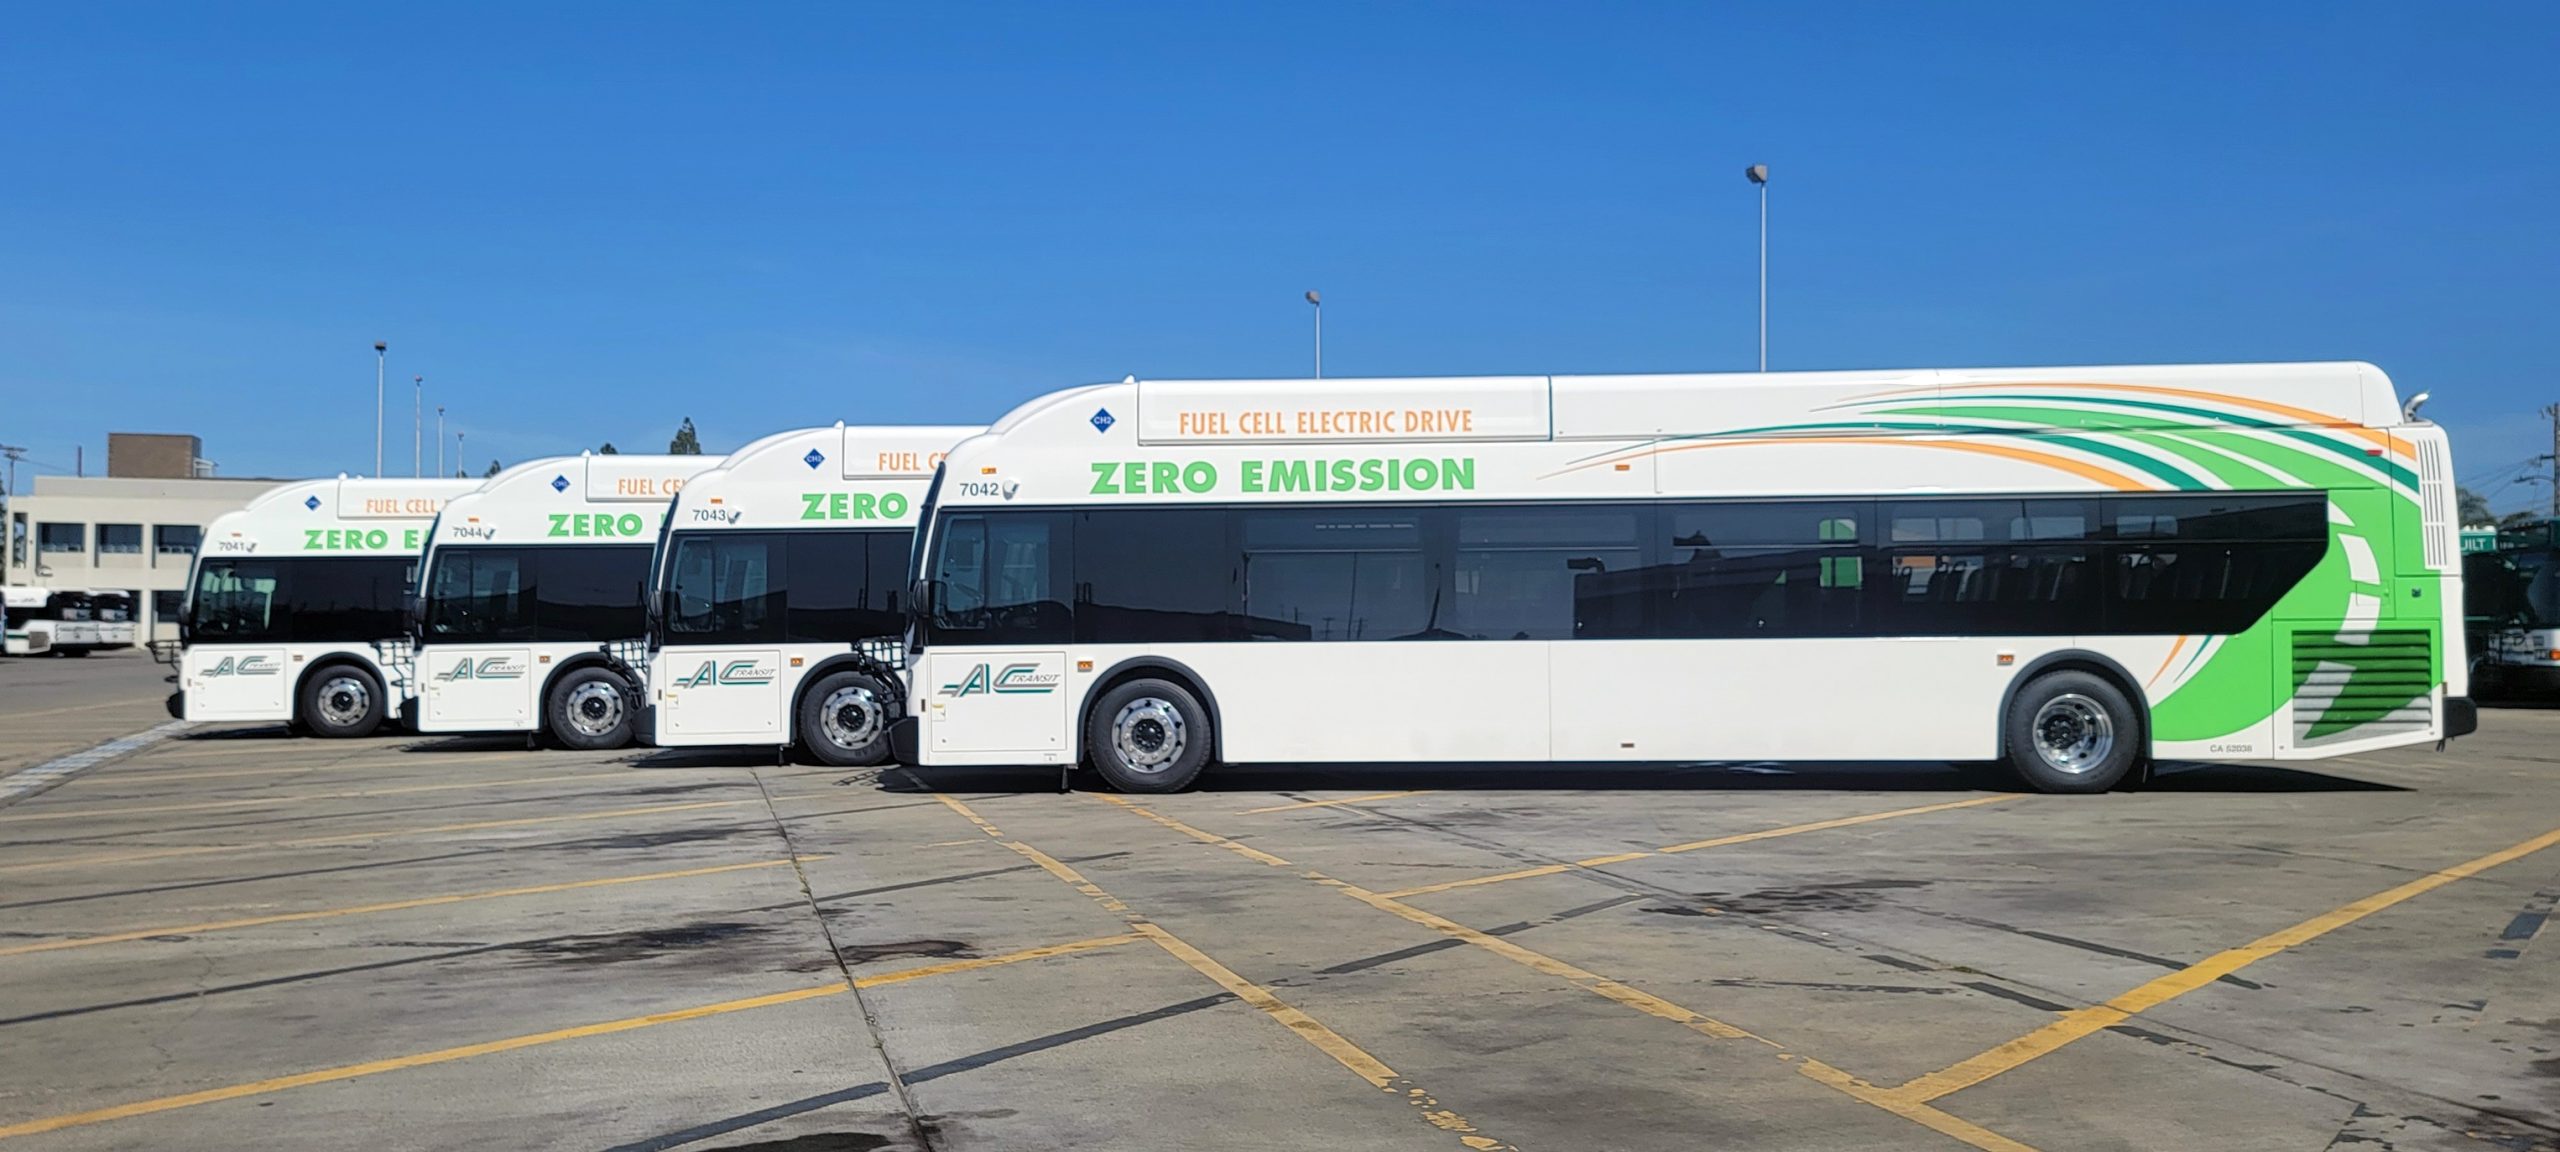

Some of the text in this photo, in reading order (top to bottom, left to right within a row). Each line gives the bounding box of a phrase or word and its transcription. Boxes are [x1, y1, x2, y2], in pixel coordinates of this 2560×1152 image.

[1179, 409, 1473, 435] FUEL CELL ELECTRIC DRIVE
[878, 452, 920, 472] FUEL
[617, 478, 656, 495] FUEL
[1090, 457, 1475, 495] ZERO EMISSION
[959, 482, 999, 497] 7042
[365, 498, 437, 513] FUEL CELL
[692, 508, 726, 521] 7043
[801, 492, 909, 520] ZERO
[452, 526, 482, 538] 7044
[547, 513, 643, 537] ZERO
[218, 541, 245, 551] 7041
[303, 528, 431, 550] ZERO E
[433, 656, 525, 682] AC
[671, 659, 777, 689] AC TRANSIT
[937, 662, 1061, 698] AC TRANSIT
